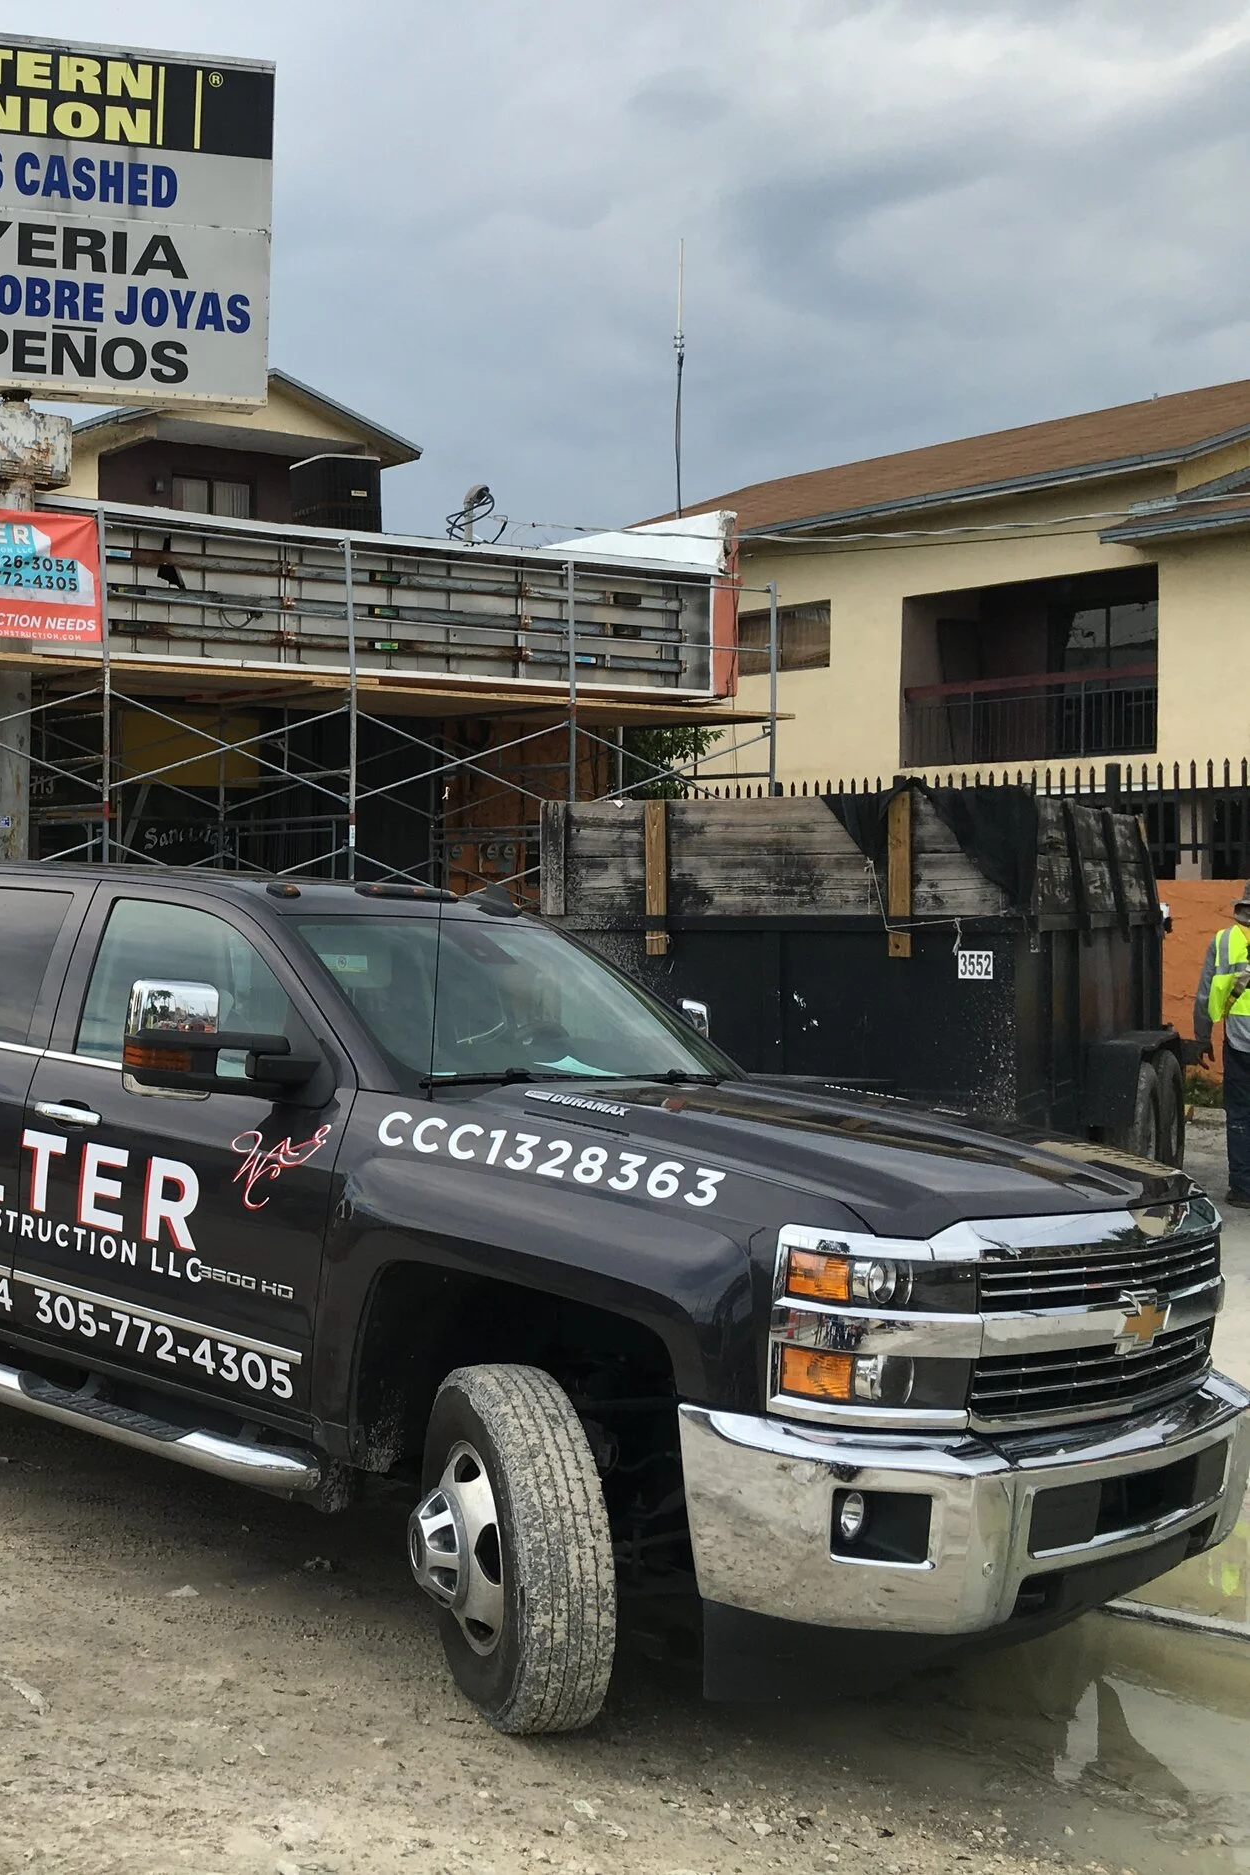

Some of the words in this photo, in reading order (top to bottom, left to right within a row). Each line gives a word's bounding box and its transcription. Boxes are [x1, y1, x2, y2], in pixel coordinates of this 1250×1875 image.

[15, 151, 178, 208] CASHED
[115, 286, 251, 334] JOYAS
[45, 616, 96, 631] NEEDS
[960, 953, 991, 977] 3552
[550, 1093, 631, 1117] DURAMAX
[377, 1111, 727, 1208] CCC1328363
[150, 1246, 203, 1284] LLC
[199, 1265, 256, 1290] 3500
[261, 1279, 294, 1300] HD
[35, 1285, 295, 1399] 305-772-4305
